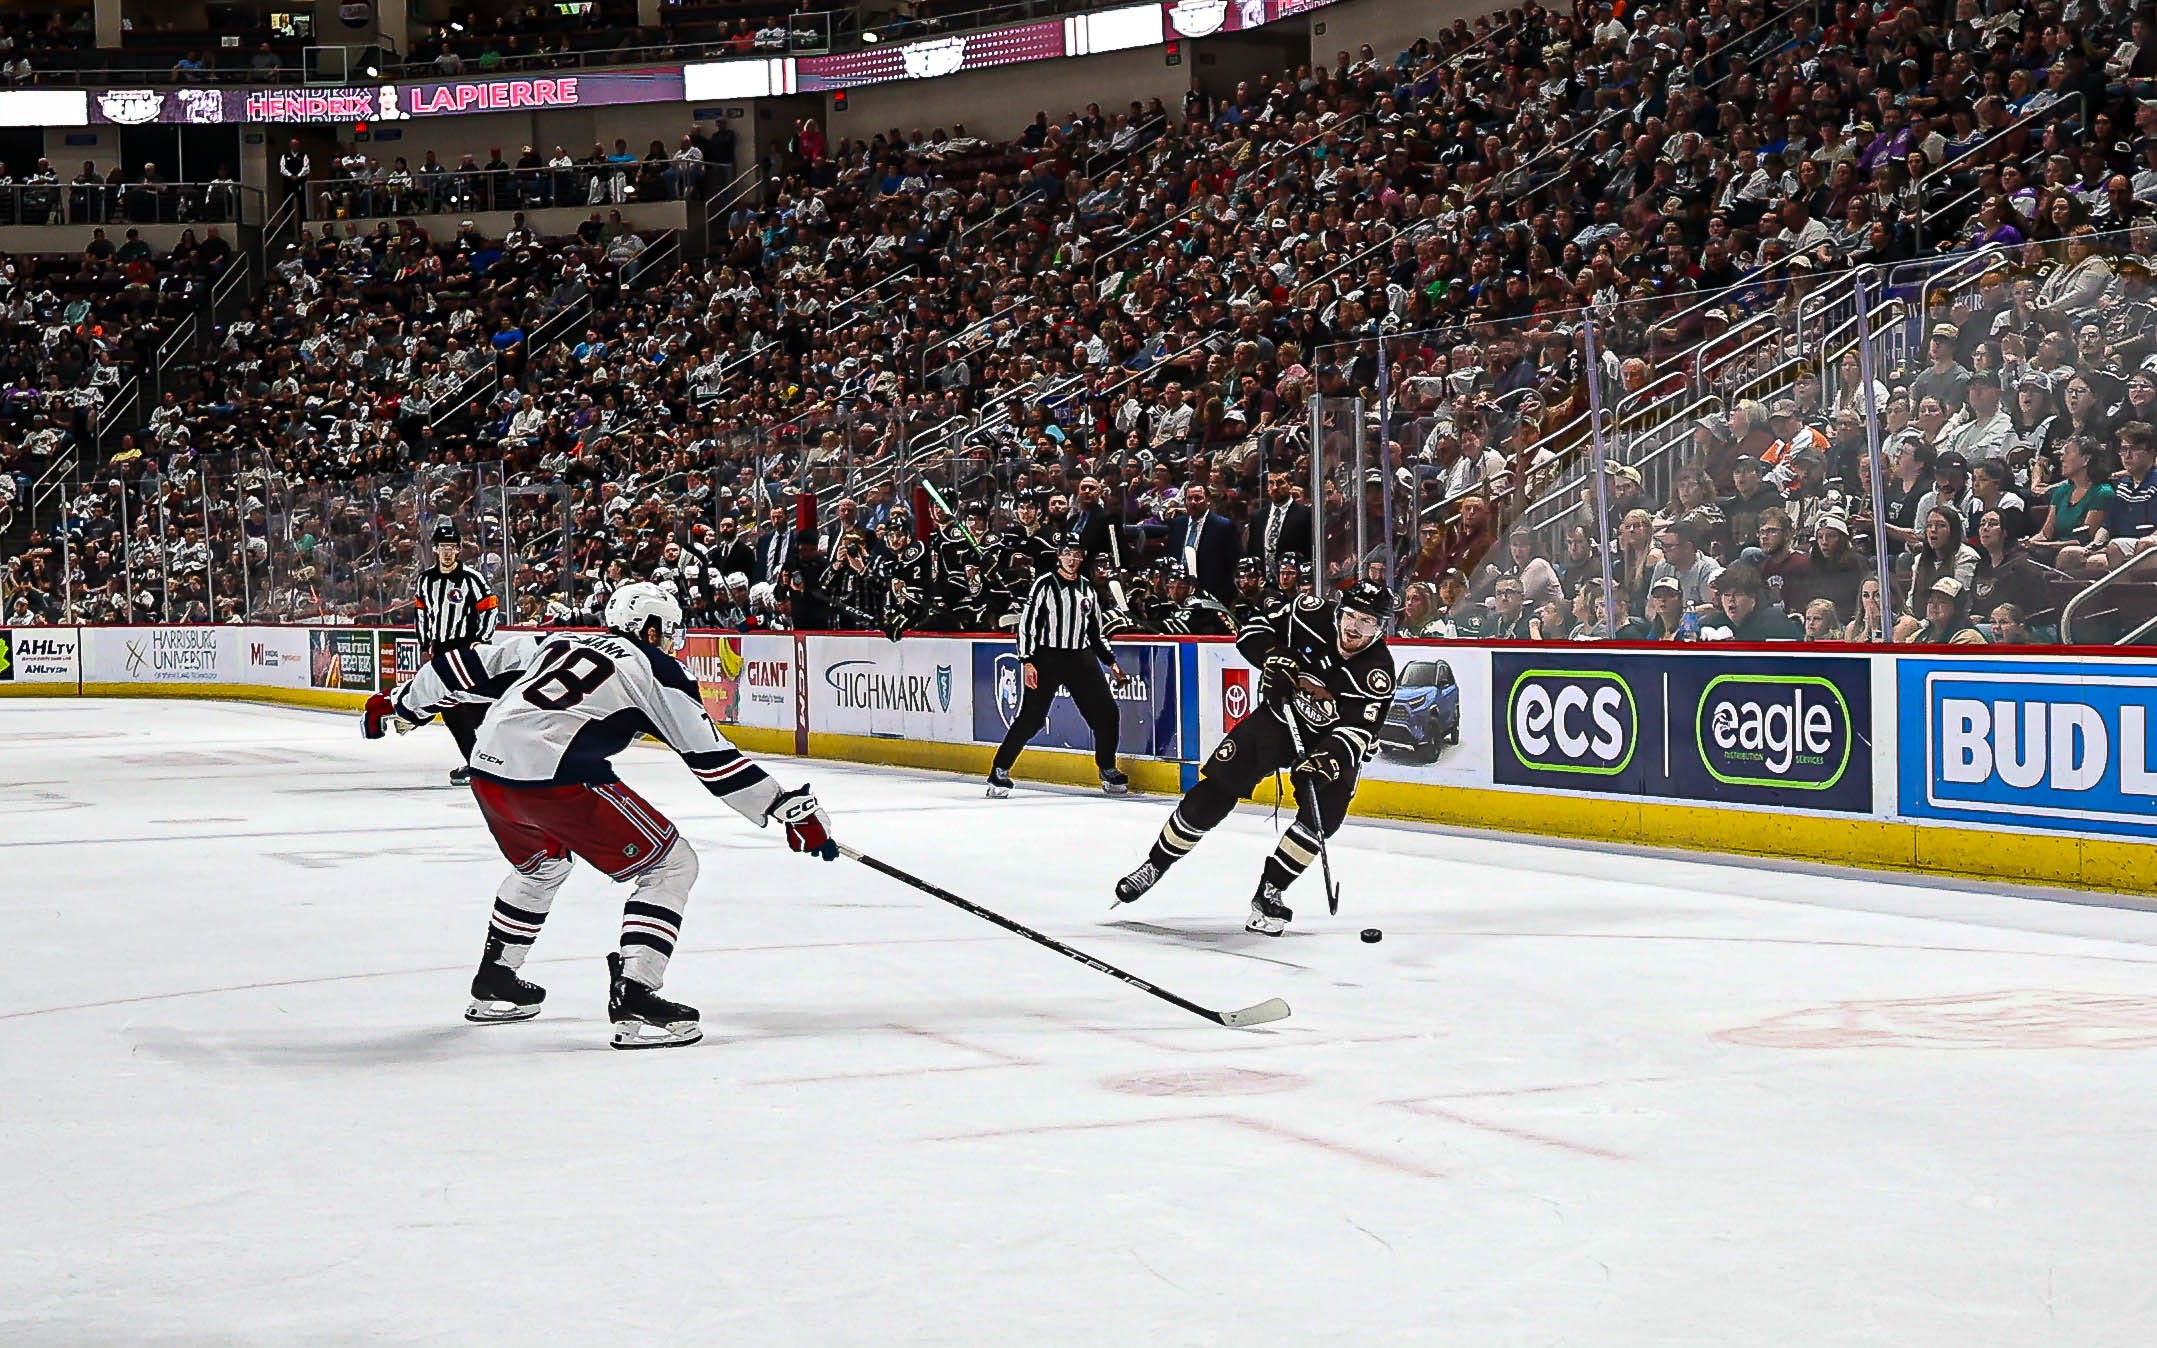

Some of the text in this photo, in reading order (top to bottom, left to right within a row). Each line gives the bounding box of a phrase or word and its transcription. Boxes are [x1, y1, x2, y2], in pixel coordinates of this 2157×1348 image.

[247, 96, 373, 117] HENDRIX
[411, 78, 578, 113] LAPIERRE
[153, 630, 217, 650] HARRISBURG
[154, 651, 217, 670] UNIVERSITY
[686, 655, 722, 683] VALUE
[747, 661, 788, 688] GIANT
[836, 672, 932, 713] HIGHMARK
[1516, 683, 1624, 761] ecs
[1712, 688, 1832, 774] eagle
[1795, 755, 1824, 765] SERVICES
[1942, 698, 2109, 792] BUD
